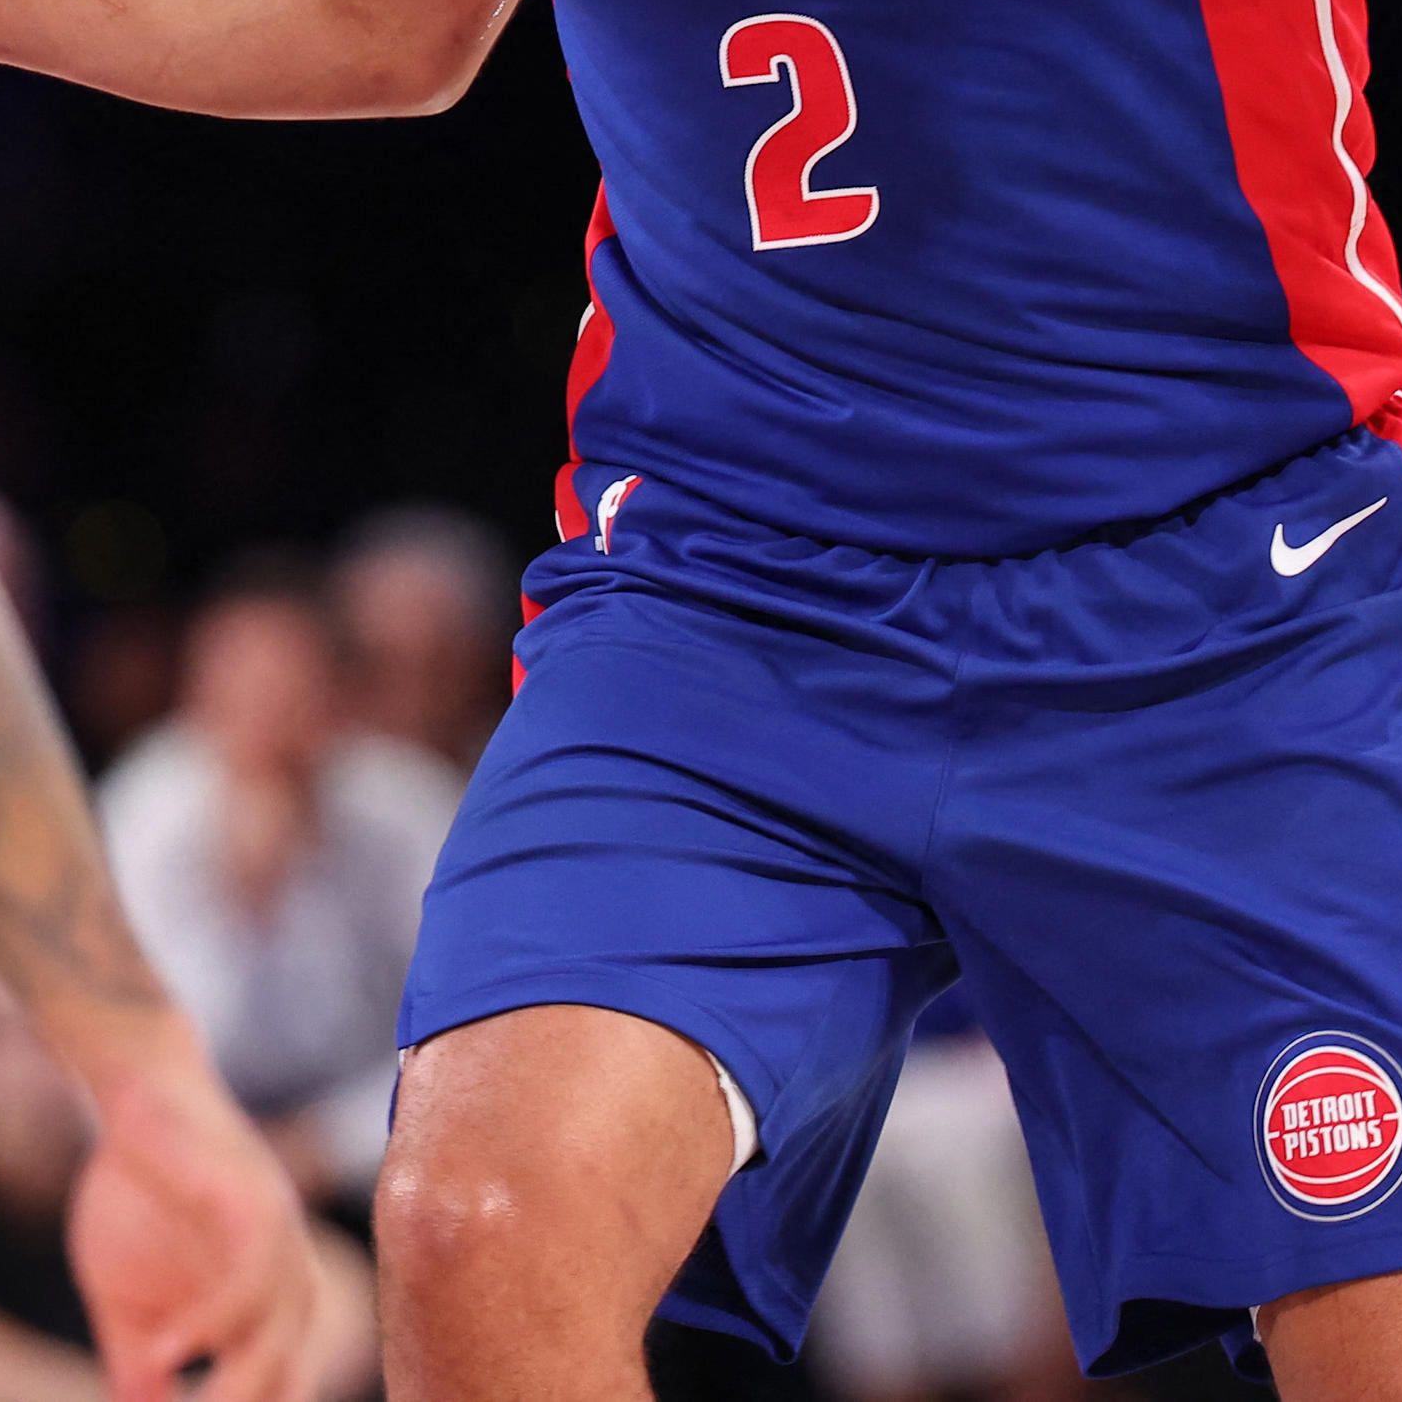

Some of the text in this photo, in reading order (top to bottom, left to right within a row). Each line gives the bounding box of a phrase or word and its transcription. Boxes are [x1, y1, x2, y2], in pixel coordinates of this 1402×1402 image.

[719, 12, 881, 252] 2
[1280, 1089, 1377, 1131] DETROIT
[1282, 1119, 1383, 1161] PISTONS
